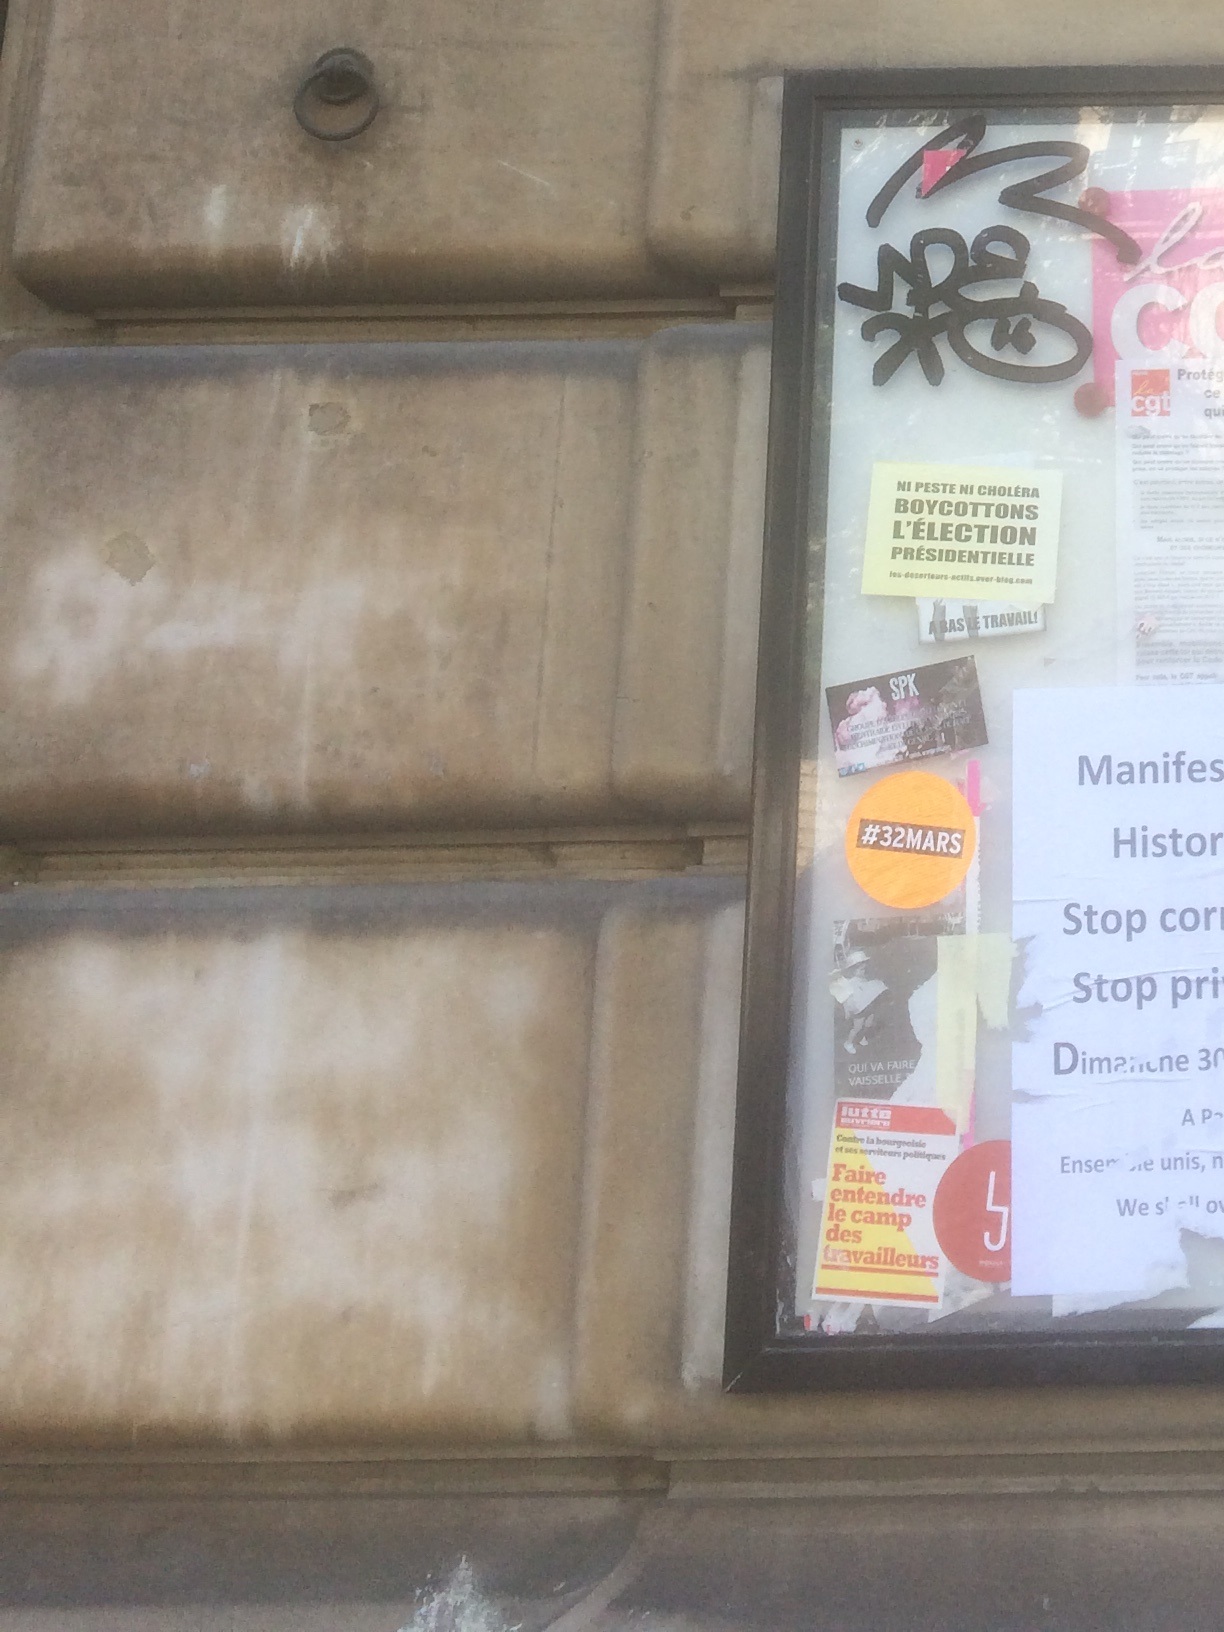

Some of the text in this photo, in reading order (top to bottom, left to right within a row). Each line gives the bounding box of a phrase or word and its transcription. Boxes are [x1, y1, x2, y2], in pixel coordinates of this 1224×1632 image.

[1204, 389, 1220, 399] ce
[1132, 394, 1172, 416] cgt
[896, 481, 1040, 498] NI PESTE NI CHOLÉRA
[894, 498, 1039, 520] BOYCOTTONS
[892, 518, 1037, 546] L'ÉLECTION
[890, 545, 1035, 566] PRÉSIDENTIELLE
[890, 673, 919, 700] SPK
[860, 823, 962, 854] #32MARS
[1062, 902, 1147, 942] Stop
[1072, 971, 1157, 1010] Stop
[848, 1059, 917, 1074] QUI VA FAIRE
[848, 1073, 902, 1087] VAISSELLE
[841, 1106, 892, 1120] lutte
[1181, 1108, 1196, 1127] A
[836, 1134, 927, 1149] Contre la bourgeoisie
[835, 1146, 946, 1162] et ses serviteurs politiques
[1161, 1151, 1206, 1172] unis,
[832, 1163, 887, 1185] Faire
[830, 1185, 927, 1209] entendre
[1116, 1197, 1149, 1217] We
[827, 1204, 913, 1232] le camp
[825, 1225, 862, 1245] des
[822, 1244, 940, 1270] travailleurs
